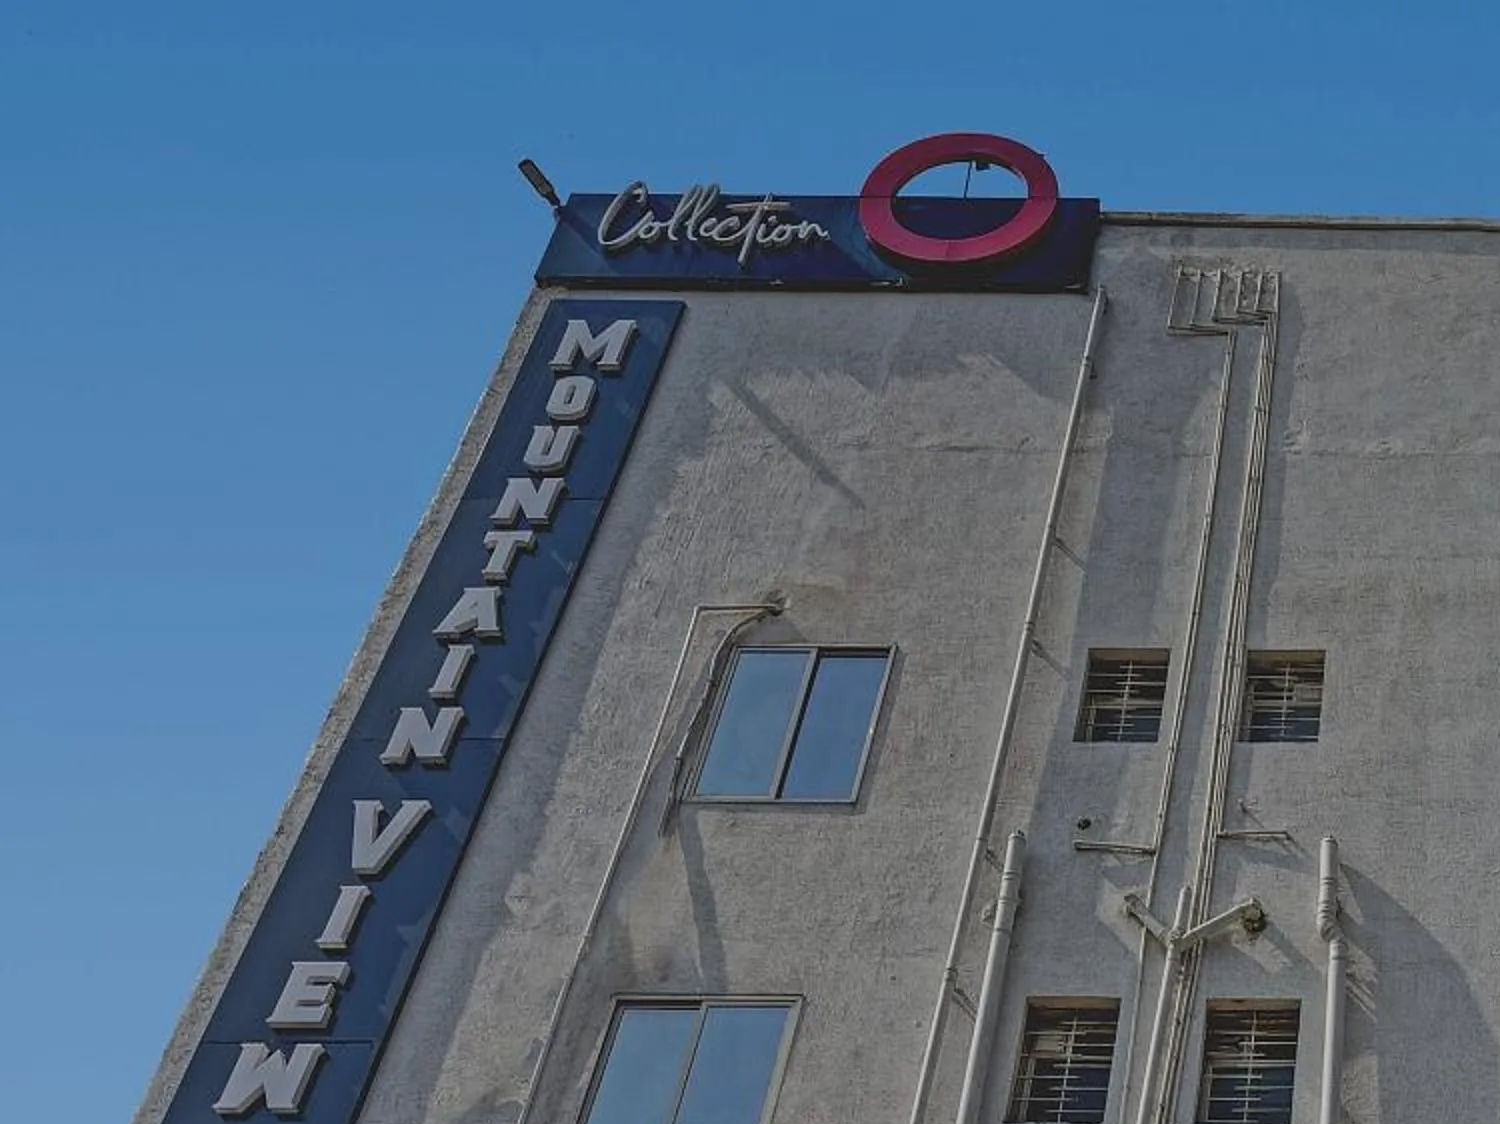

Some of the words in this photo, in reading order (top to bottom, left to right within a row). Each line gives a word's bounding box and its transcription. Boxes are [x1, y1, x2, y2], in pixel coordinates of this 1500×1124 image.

[597, 181, 829, 269] Collection
[380, 318, 638, 768] MOUNTAIN
[211, 799, 434, 1115] VIEW
